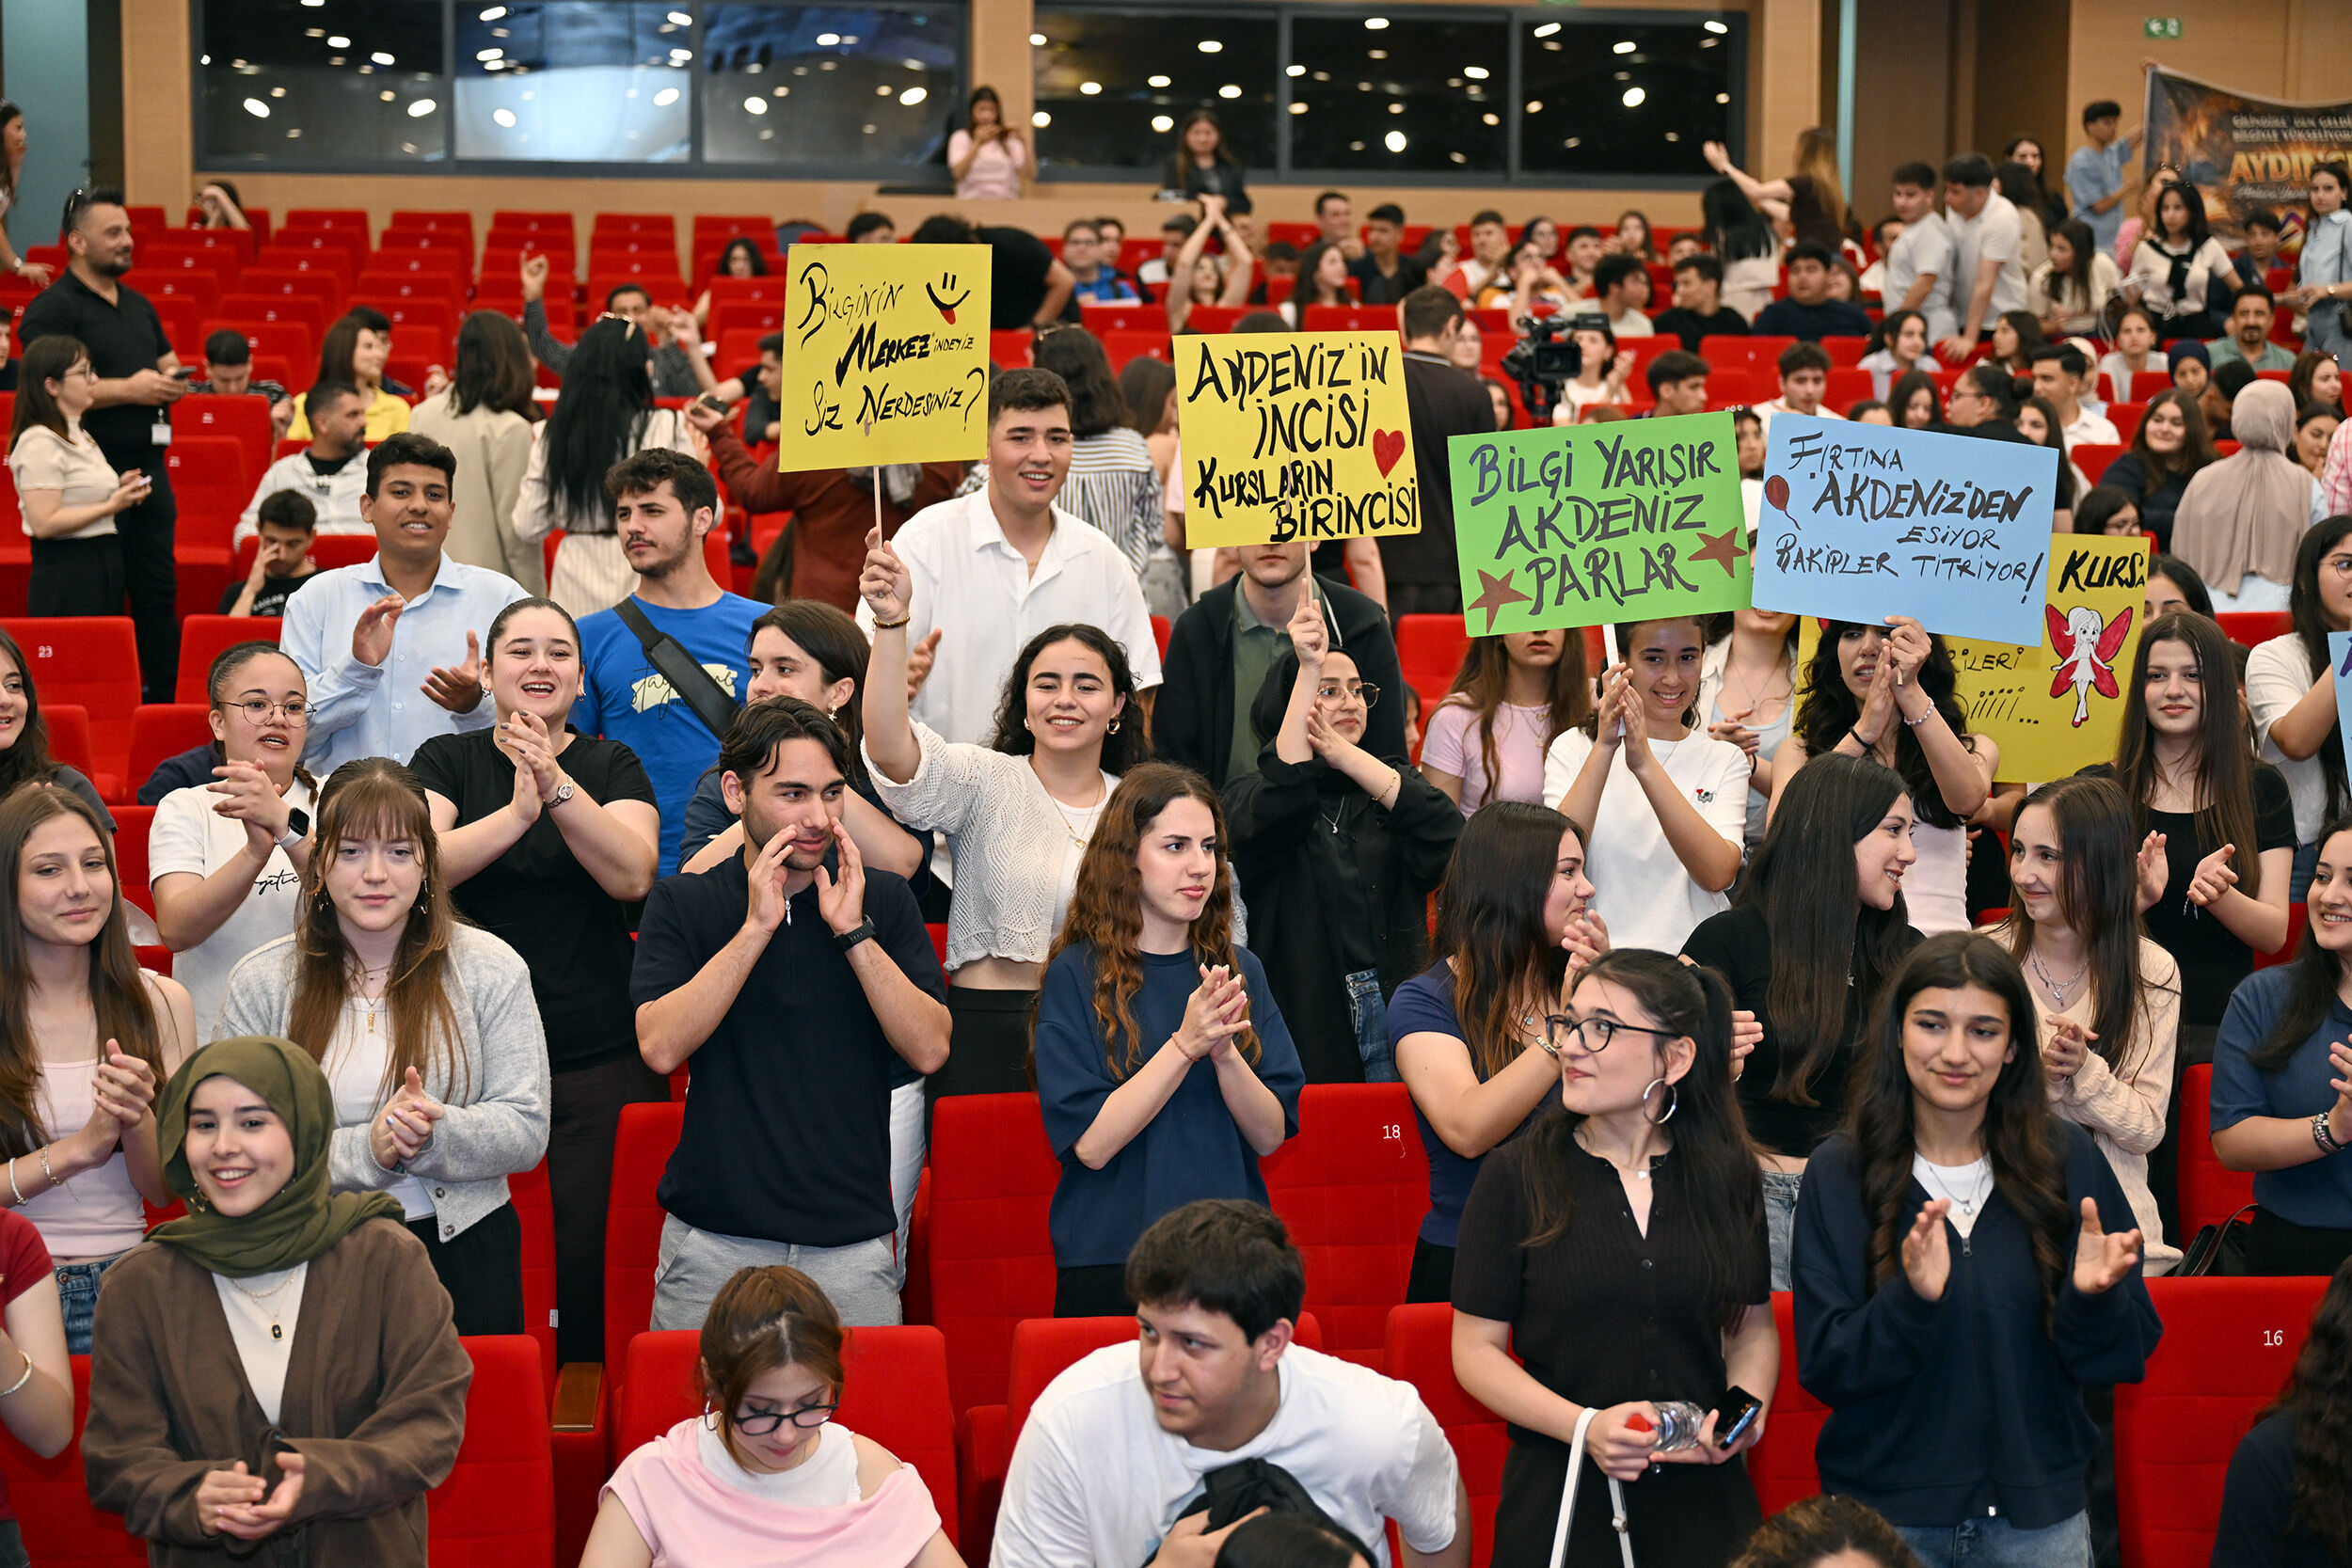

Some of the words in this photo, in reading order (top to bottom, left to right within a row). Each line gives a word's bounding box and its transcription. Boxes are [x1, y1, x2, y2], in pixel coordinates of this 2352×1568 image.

[805, 380, 843, 436] SİZ
[1252, 388, 1370, 459] İNCİSİ
[1469, 440, 1573, 507] BİLGİ
[1594, 435, 1722, 489] YARIŞIR
[1788, 431, 1903, 472] FIRTINA
[1194, 457, 1333, 518] KURSLARIN
[1270, 478, 1417, 543] BİRİNCİSİ
[1494, 490, 1707, 561] AKDENİZ
[1896, 525, 2000, 550] ESİYOR
[1524, 542, 1699, 616] PARLAR
[1775, 532, 1899, 578] RAKİPLER
[1912, 552, 2044, 604] TİTRİYOR!
[38, 645, 53, 658] 23
[1382, 1124, 1401, 1139] 18
[2263, 1329, 2284, 1346] 16
